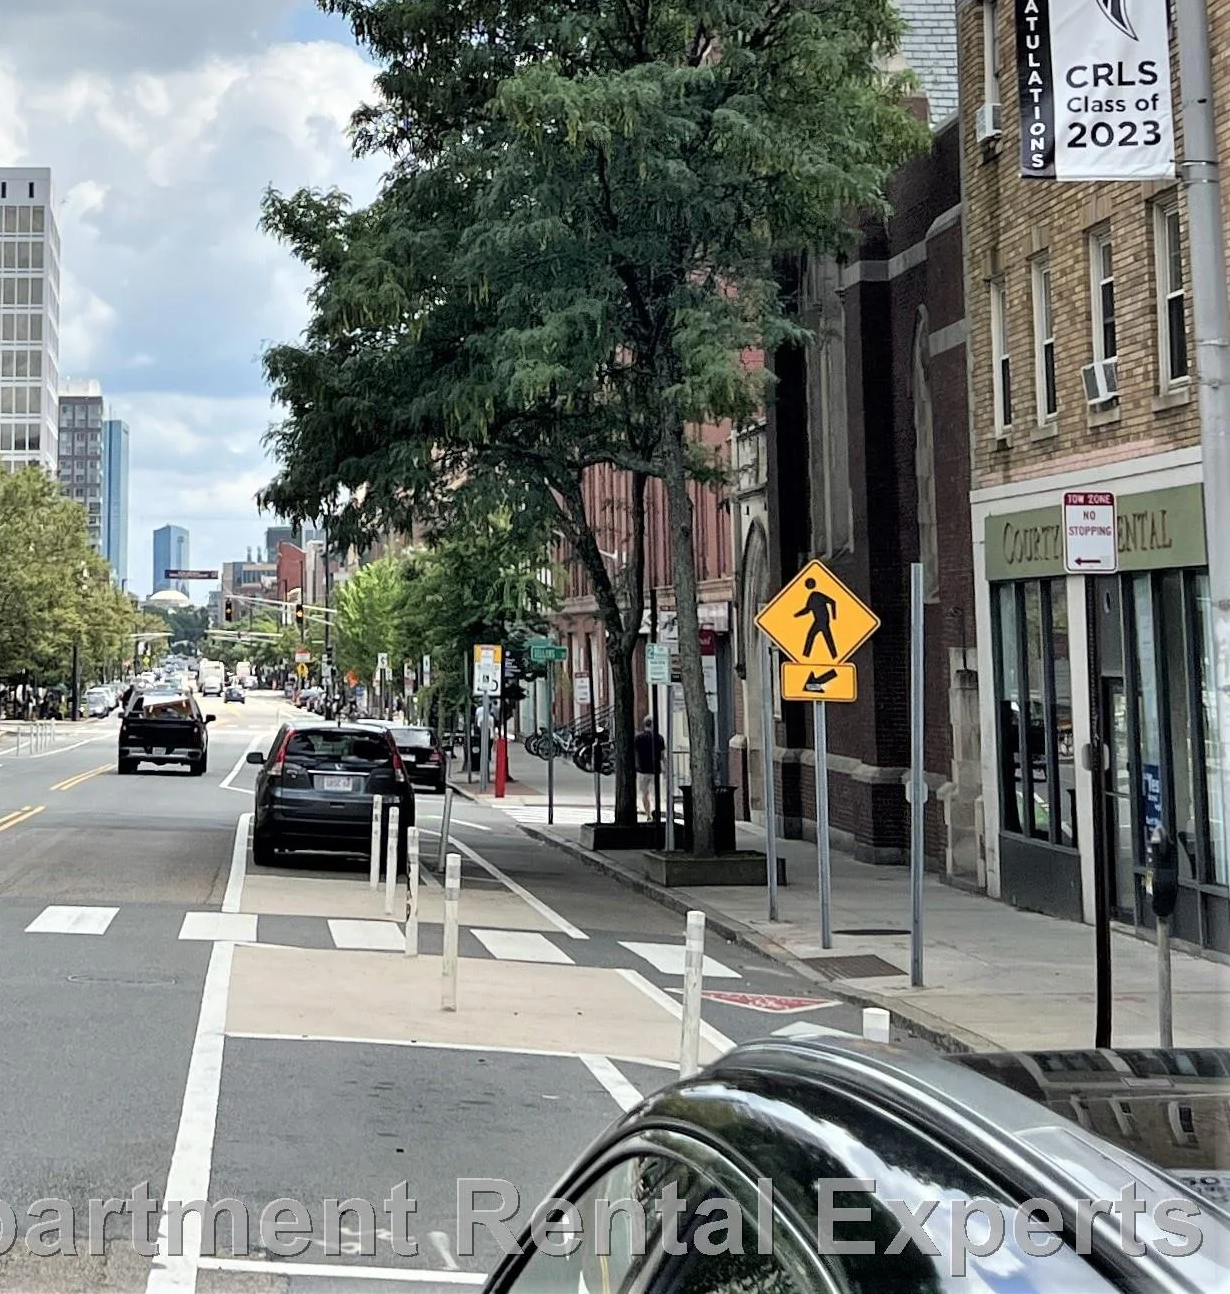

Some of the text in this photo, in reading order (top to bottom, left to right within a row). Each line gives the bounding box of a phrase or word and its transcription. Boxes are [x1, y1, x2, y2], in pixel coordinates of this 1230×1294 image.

[1065, 61, 1158, 89] CRLS
[1066, 93, 1159, 113] Class of
[1066, 120, 1161, 149] 2023
[1067, 494, 1112, 505] TOW ZONE
[1083, 510, 1096, 521] NO
[1069, 526, 1112, 536] STOPPING
